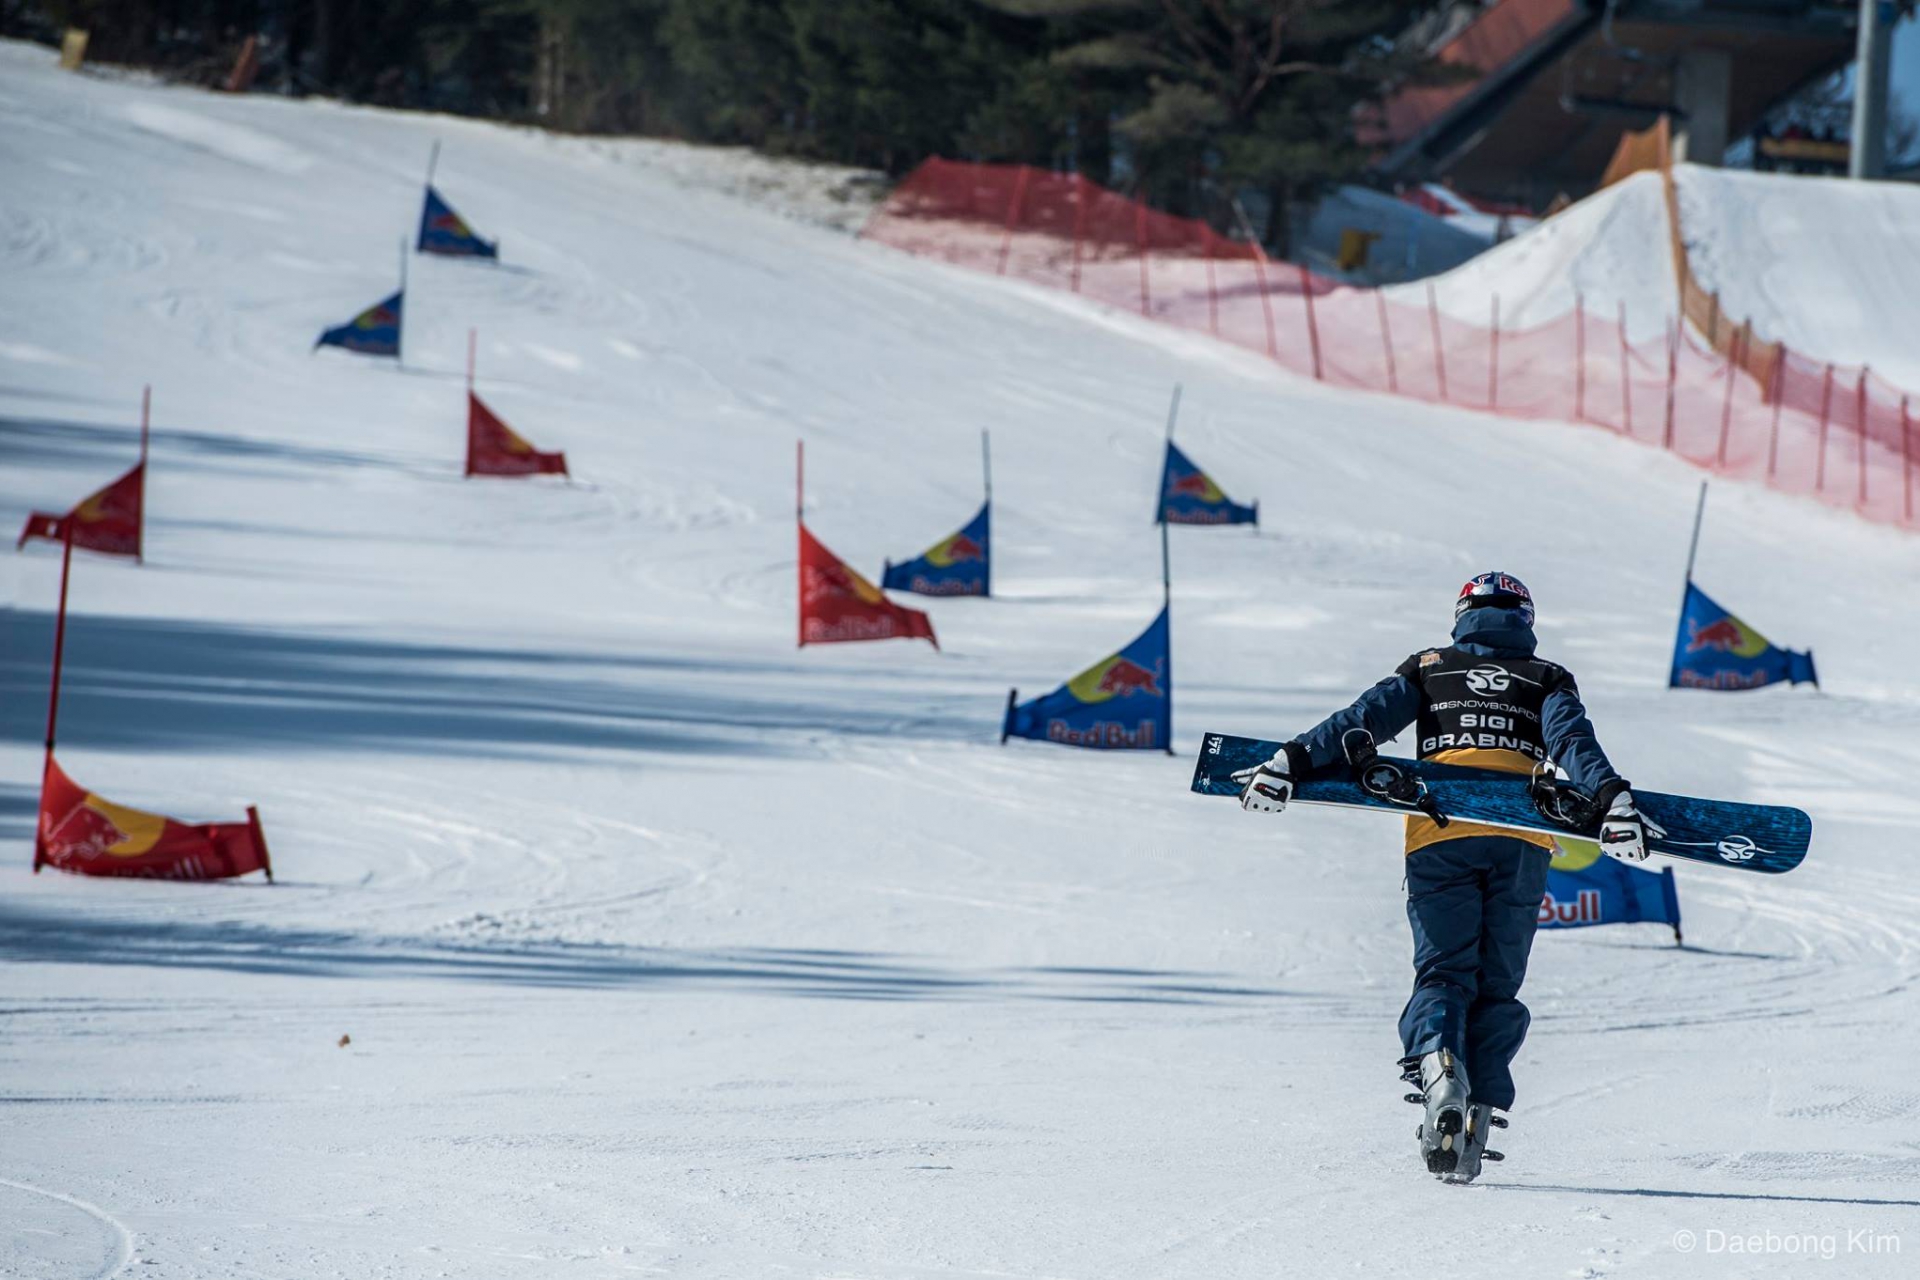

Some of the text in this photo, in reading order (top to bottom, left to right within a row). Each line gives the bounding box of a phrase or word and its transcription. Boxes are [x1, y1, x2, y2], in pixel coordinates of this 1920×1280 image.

[1047, 719, 1156, 750] Red Bull
[1460, 714, 1514, 731] SIGI
[1208, 736, 1220, 754] 170
[1536, 890, 1601, 926] Bull
